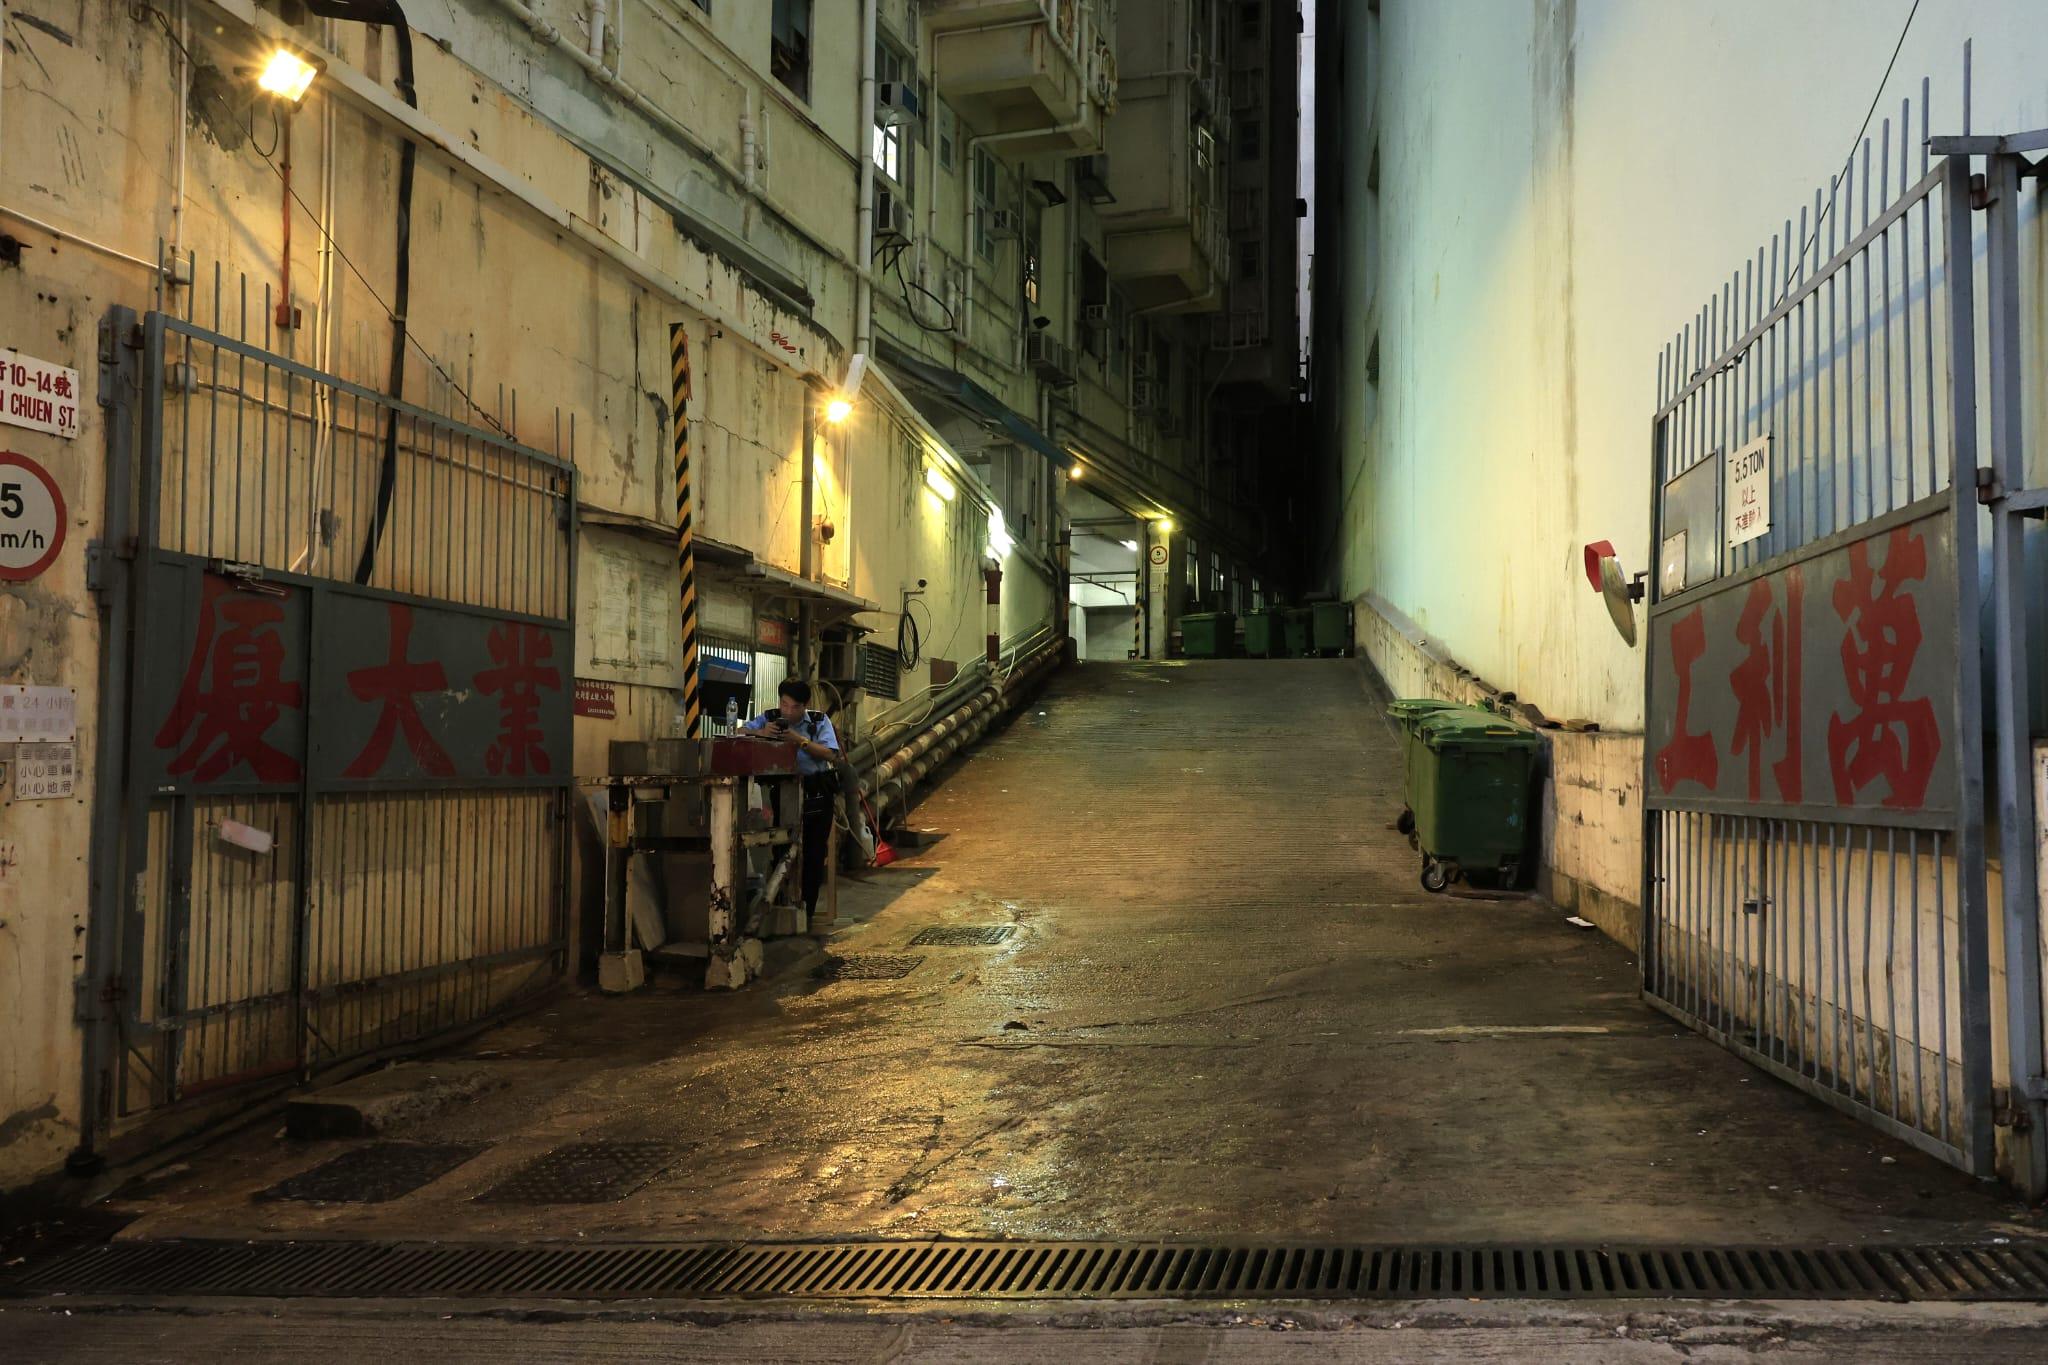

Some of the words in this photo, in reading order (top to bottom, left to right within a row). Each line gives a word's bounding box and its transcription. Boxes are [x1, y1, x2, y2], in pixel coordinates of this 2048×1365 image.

[11, 393, 52, 424] CHUEN
[58, 406, 76, 430] ST.
[1, 483, 24, 518] 5
[0, 529, 44, 549] m/h
